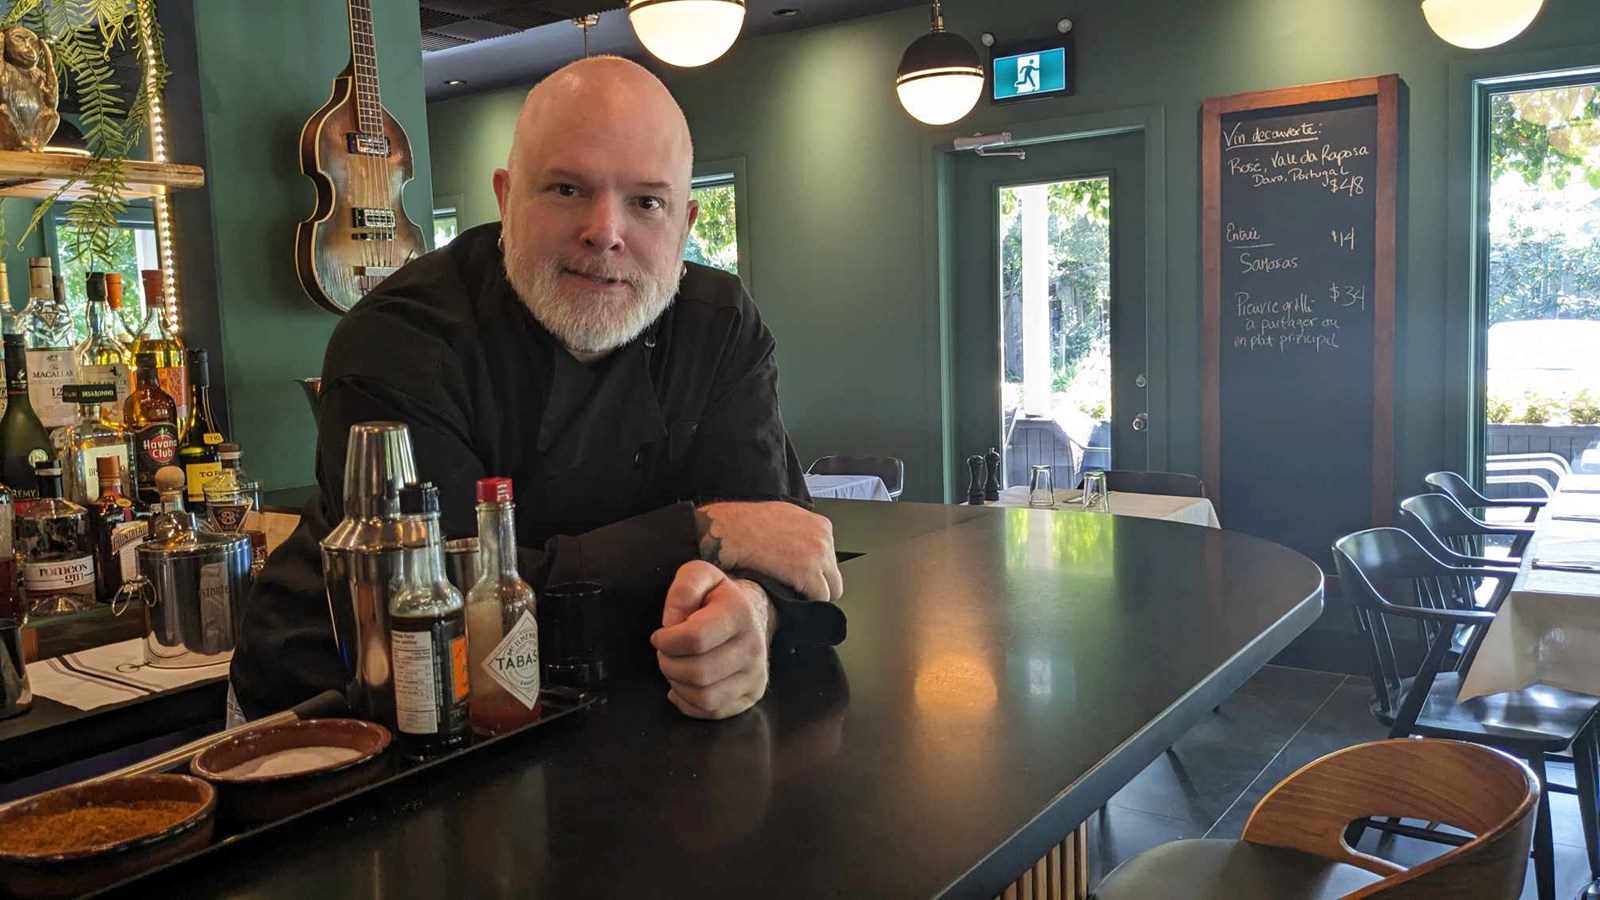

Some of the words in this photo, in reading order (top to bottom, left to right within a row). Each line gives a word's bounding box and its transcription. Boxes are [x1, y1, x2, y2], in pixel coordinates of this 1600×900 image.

[1223, 122, 1246, 146] Vin
[1271, 150, 1297, 168] Vale
[1300, 149, 1318, 164] da
[1321, 144, 1369, 167] Raposa
[1288, 166, 1349, 187] Portugal
[1330, 175, 1364, 197] $48
[1331, 226, 1355, 250] $14
[1234, 291, 1279, 317] Pieuvre
[1261, 315, 1319, 336] partager
[1321, 317, 1340, 329] ou
[1233, 336, 1247, 347] en
[1251, 333, 1274, 351] plat
[1280, 332, 1340, 352] principal
[143, 438, 178, 450] Havana
[152, 447, 173, 459] Club
[39, 562, 88, 577] romeos
[64, 571, 85, 586] gin
